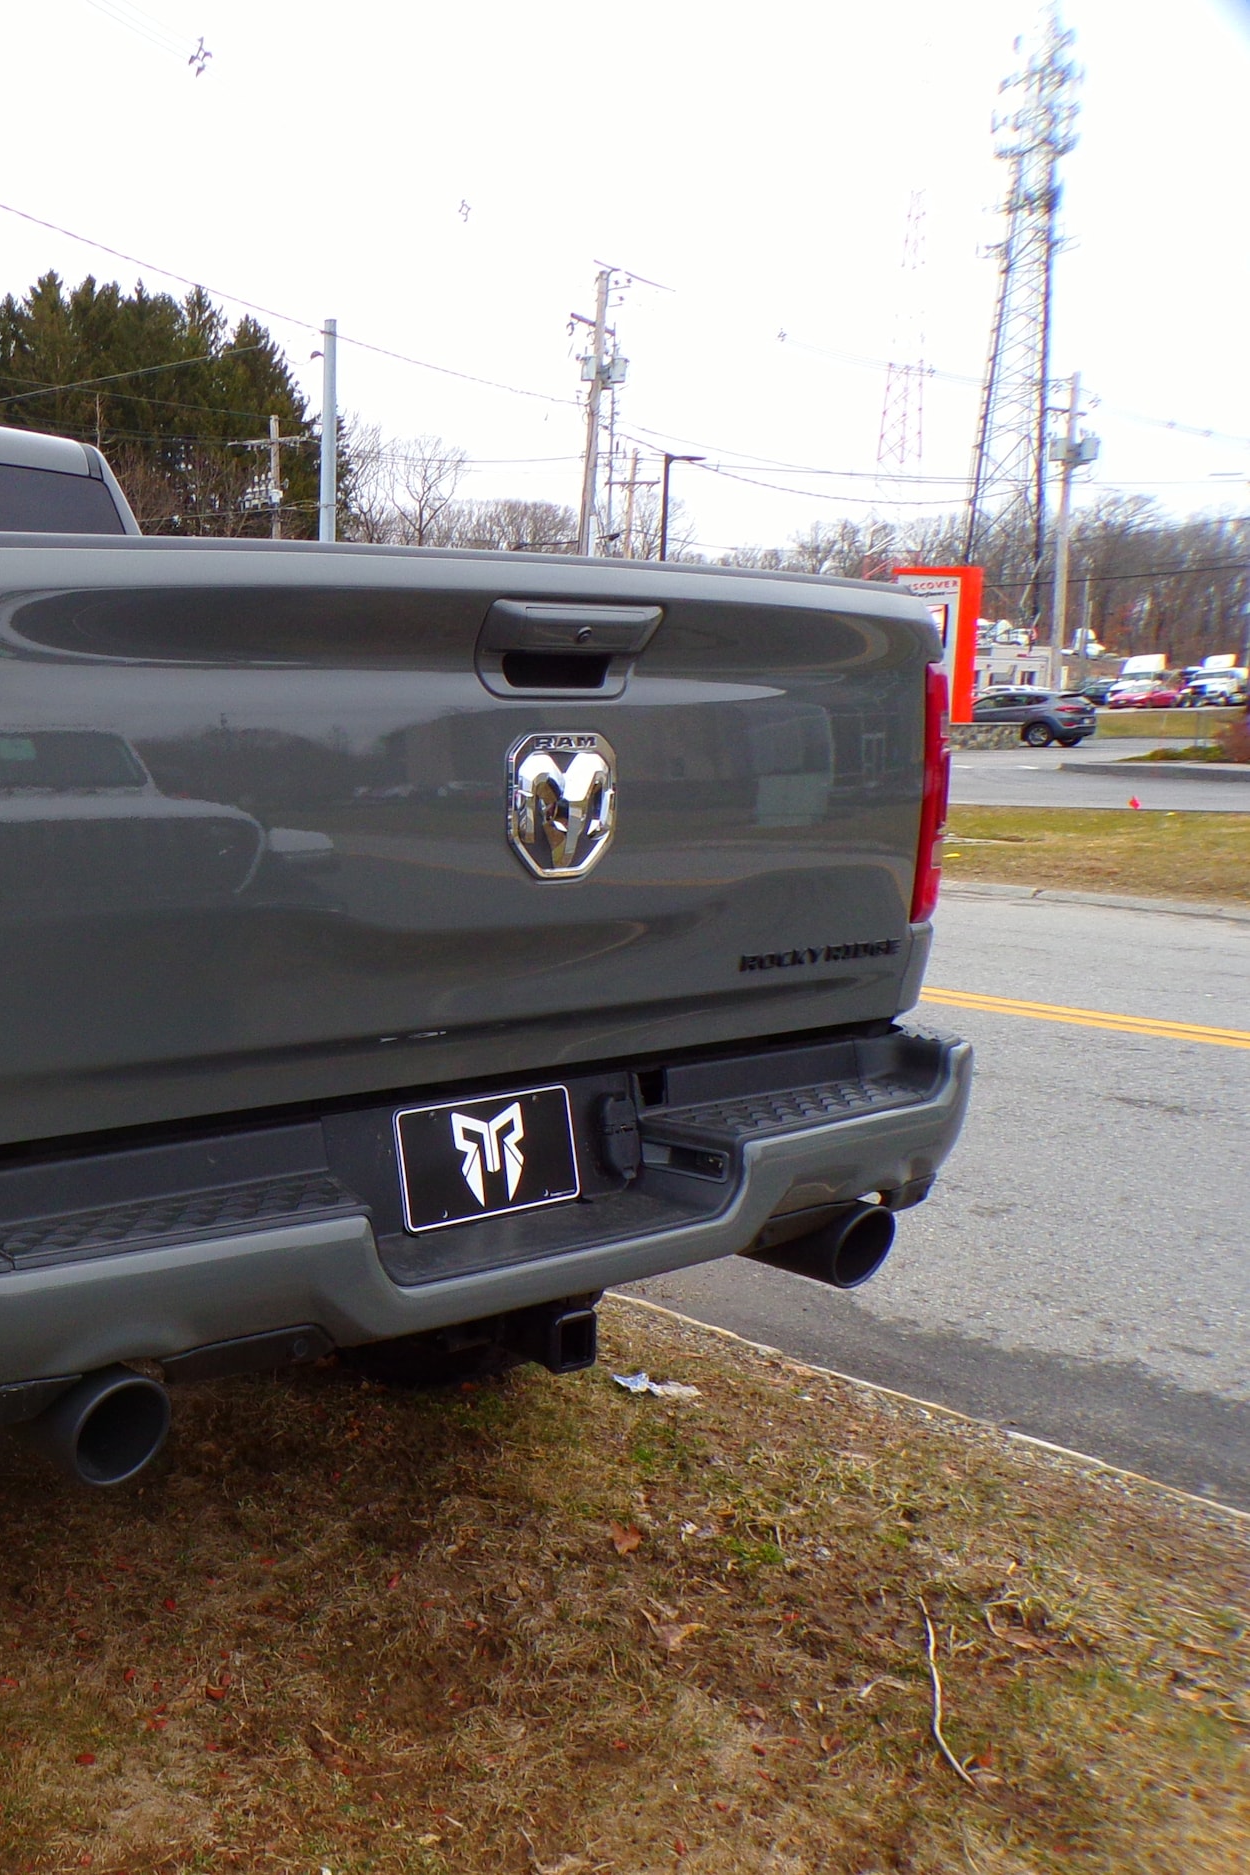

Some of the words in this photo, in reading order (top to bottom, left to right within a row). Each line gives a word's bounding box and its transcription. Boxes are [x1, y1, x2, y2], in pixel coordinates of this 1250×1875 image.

[534, 736, 597, 749] RAM
[739, 946, 823, 972] ROCKY
[824, 937, 901, 962] RIDGE
